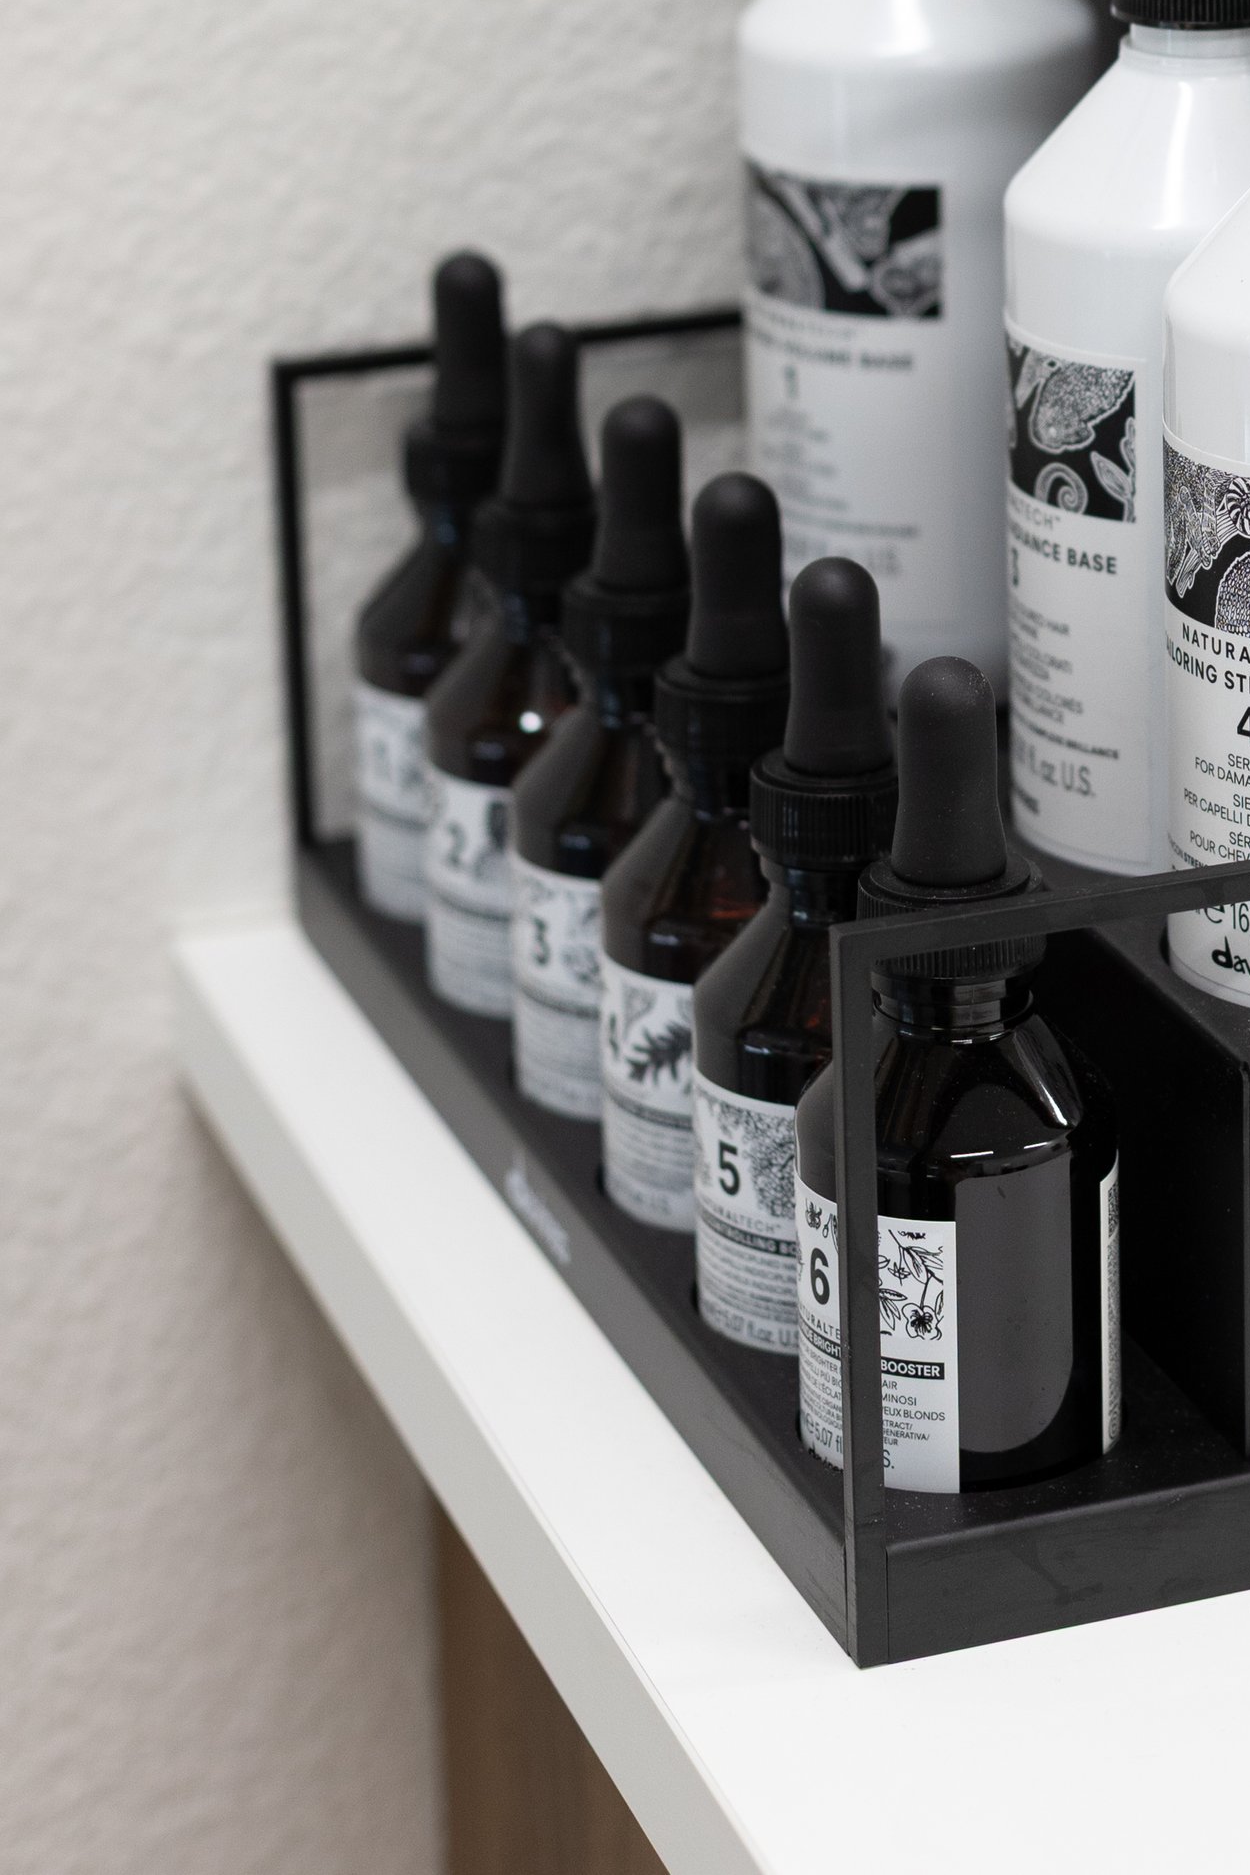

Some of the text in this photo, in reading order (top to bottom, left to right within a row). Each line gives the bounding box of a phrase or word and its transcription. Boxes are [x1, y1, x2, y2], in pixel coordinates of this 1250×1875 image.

[1066, 547, 1118, 576] BASE
[1194, 756, 1215, 778] FOR
[1183, 787, 1198, 809] PER
[1199, 798, 1243, 825] CAPELLI
[1190, 830, 1216, 854] POUR
[718, 1139, 741, 1197] 5
[810, 1247, 830, 1305] 6
[881, 1360, 940, 1377] BOOSTER
[882, 1380, 898, 1391] AIR
[903, 1409, 946, 1421] BLONDS
